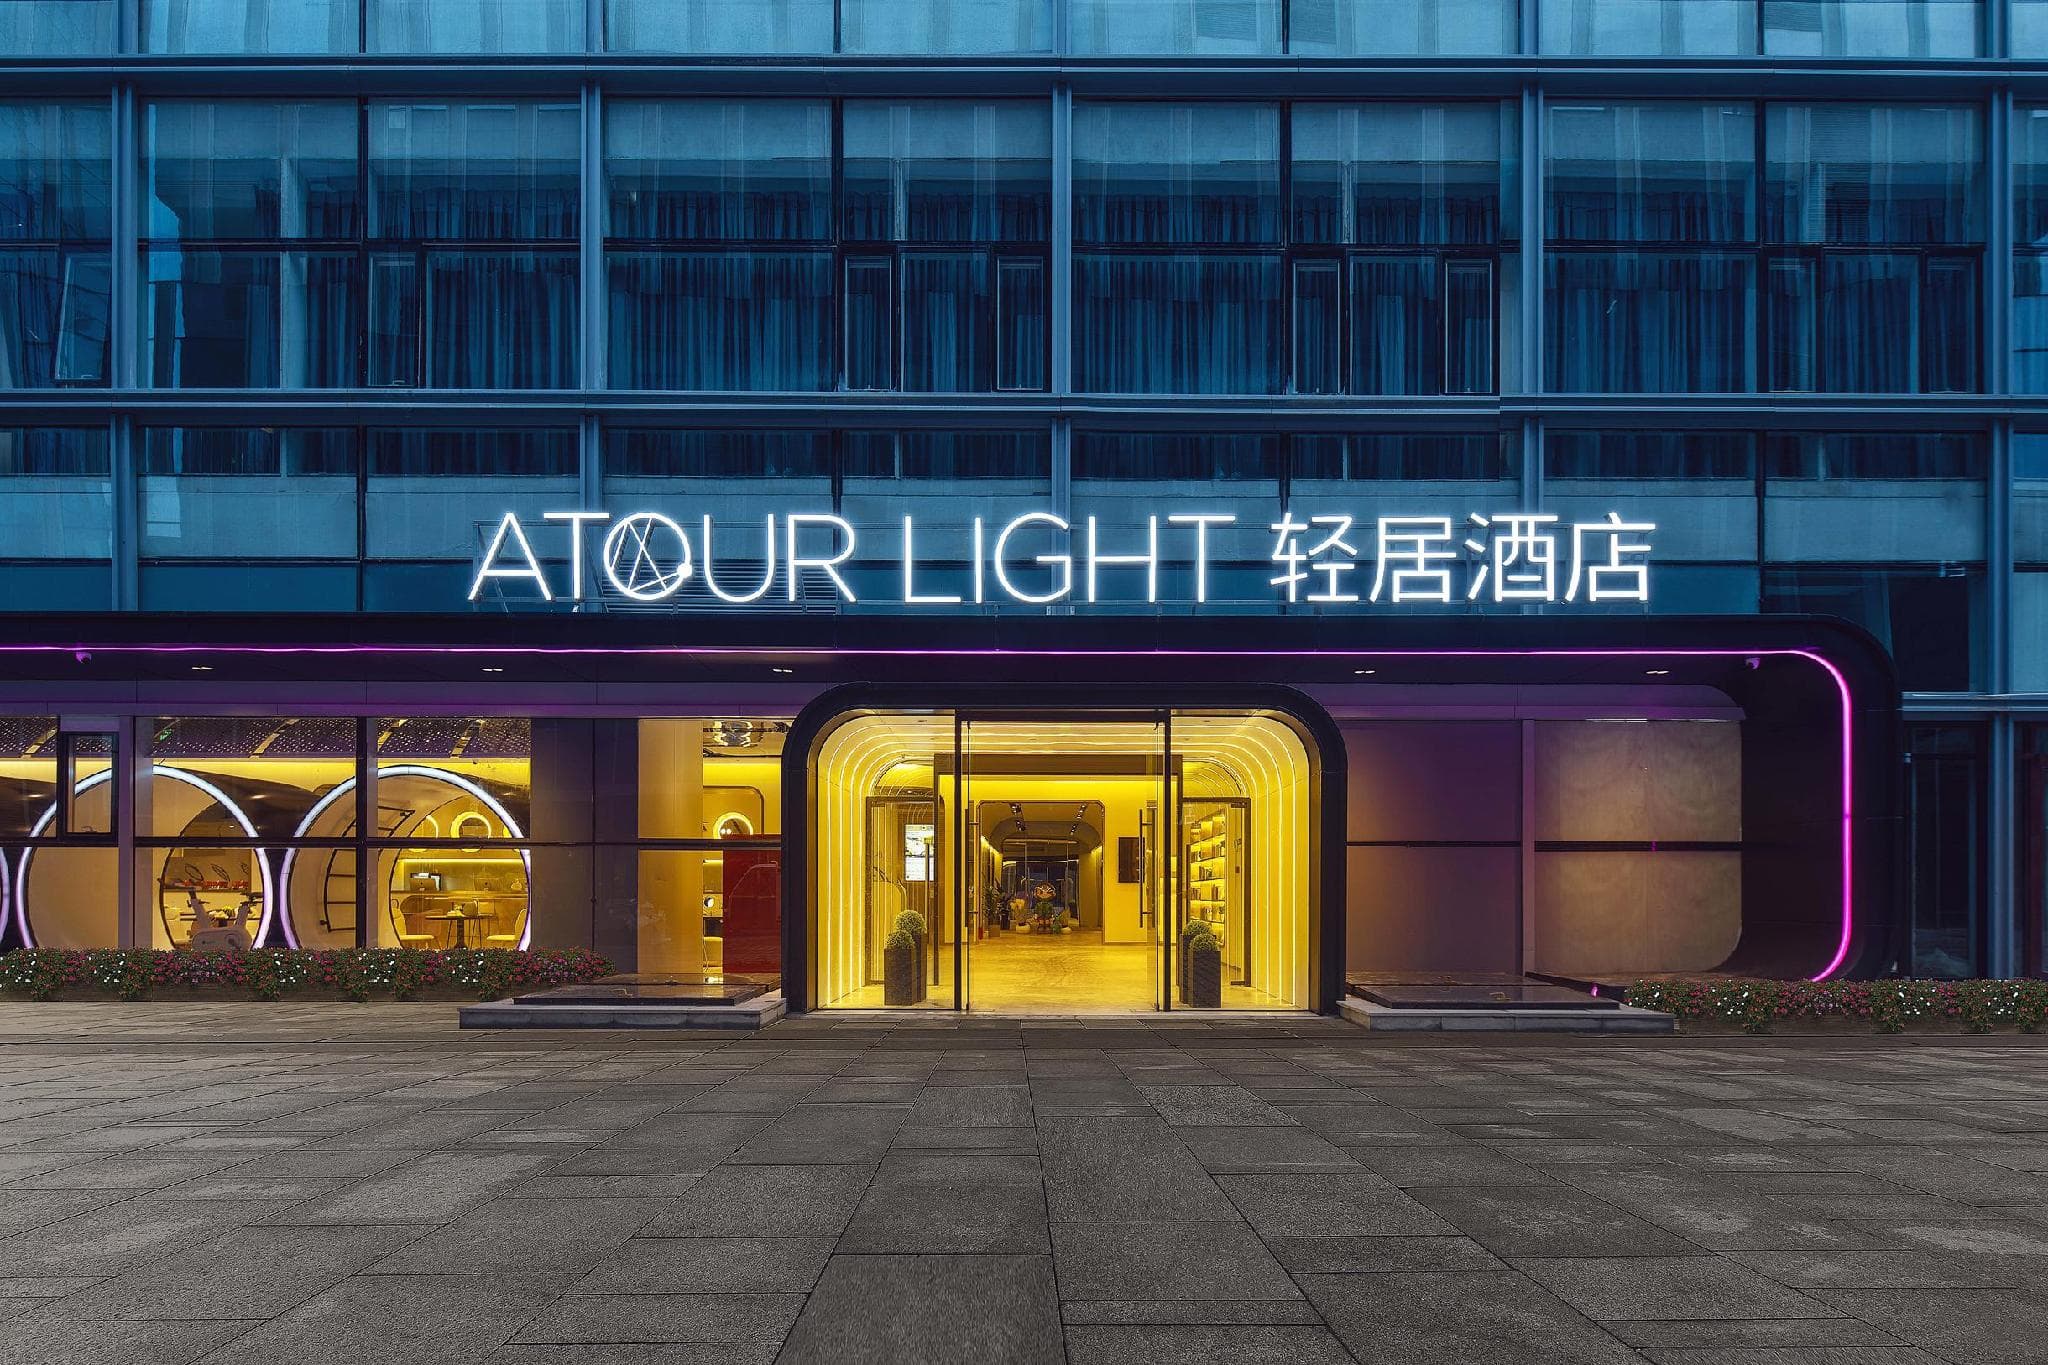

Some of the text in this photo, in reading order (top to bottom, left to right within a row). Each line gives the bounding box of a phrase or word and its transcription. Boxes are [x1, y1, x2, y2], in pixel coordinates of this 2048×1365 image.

[468, 511, 1657, 604] ATOUR LIGHT 轻居酒店
